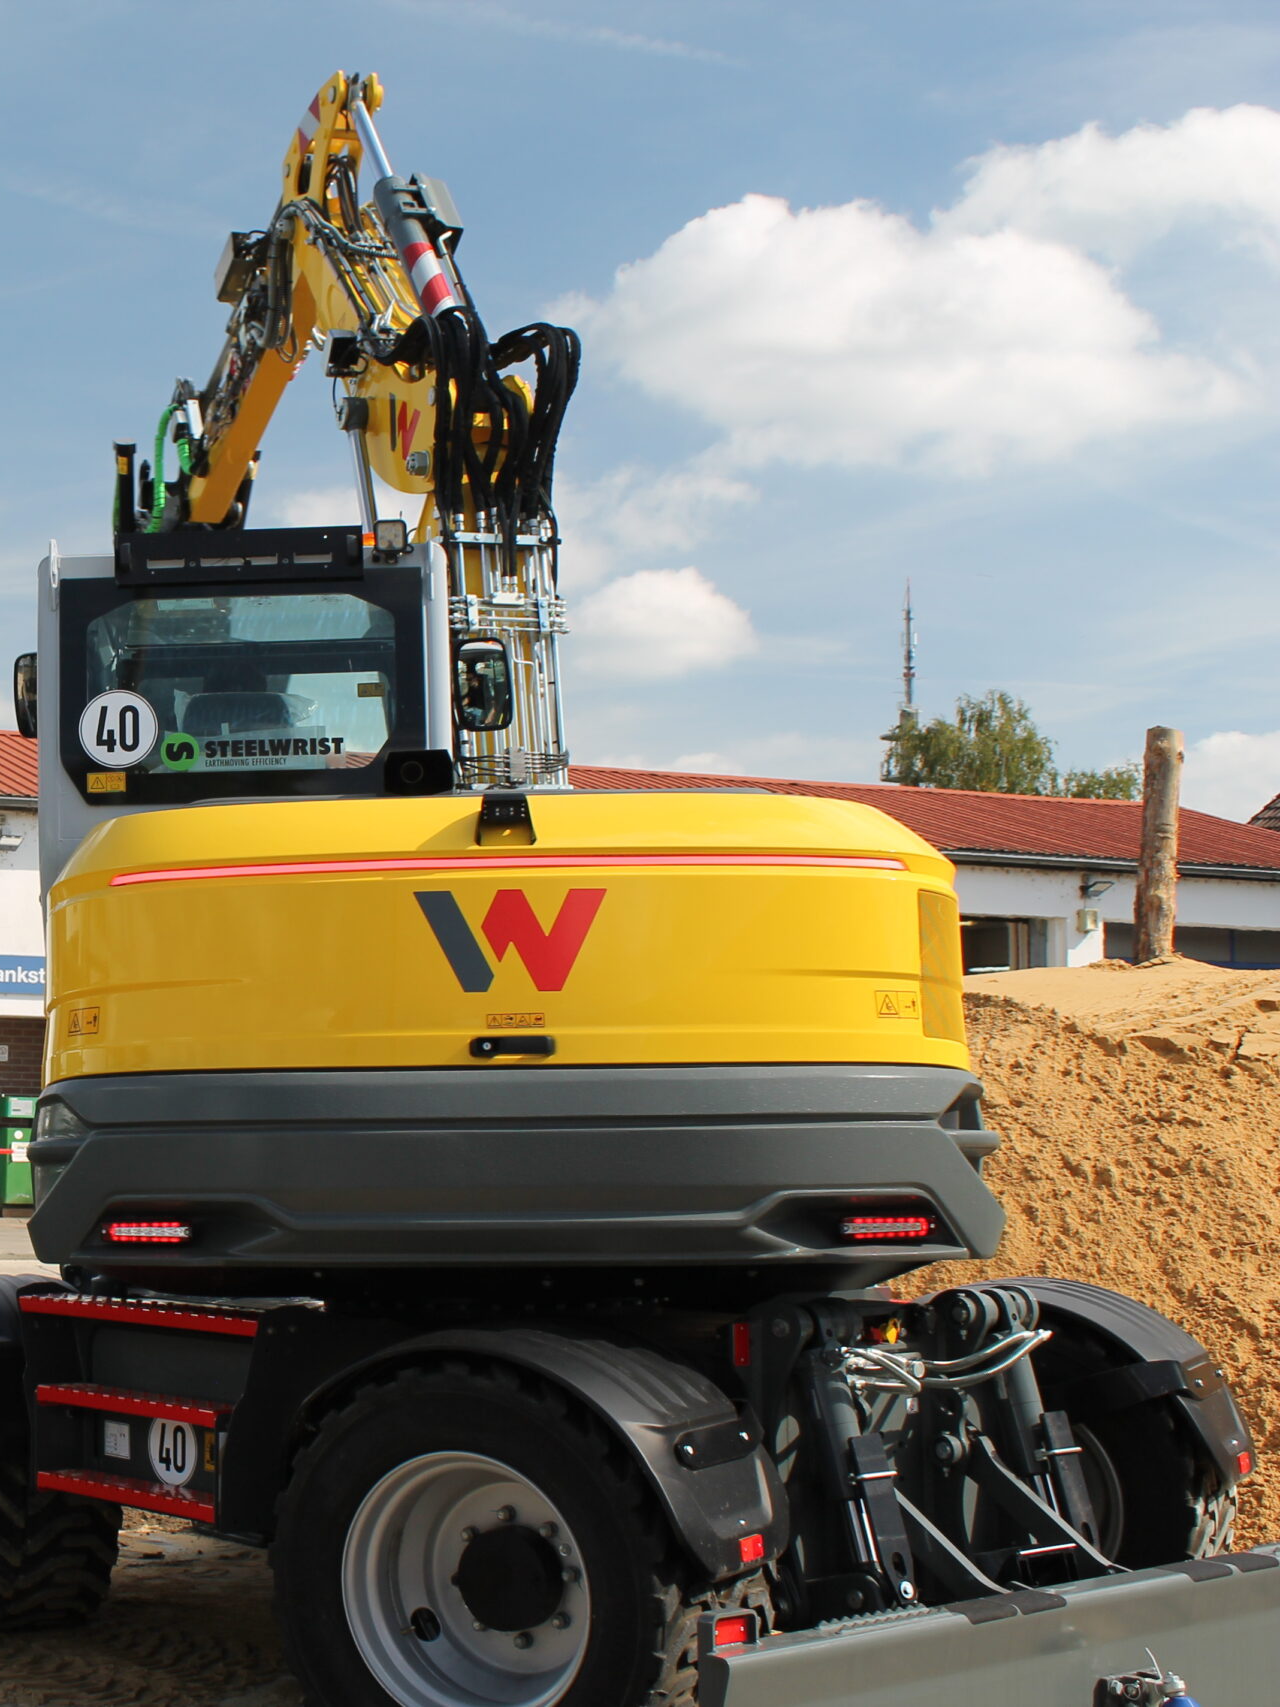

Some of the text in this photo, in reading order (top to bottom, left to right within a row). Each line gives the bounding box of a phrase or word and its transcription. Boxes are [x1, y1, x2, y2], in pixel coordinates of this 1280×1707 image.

[96, 705, 140, 752] 40
[205, 737, 344, 758] STEELWRIST
[205, 757, 287, 768] EARTHMOVING EFFICIENCY
[158, 1422, 186, 1474] 40
